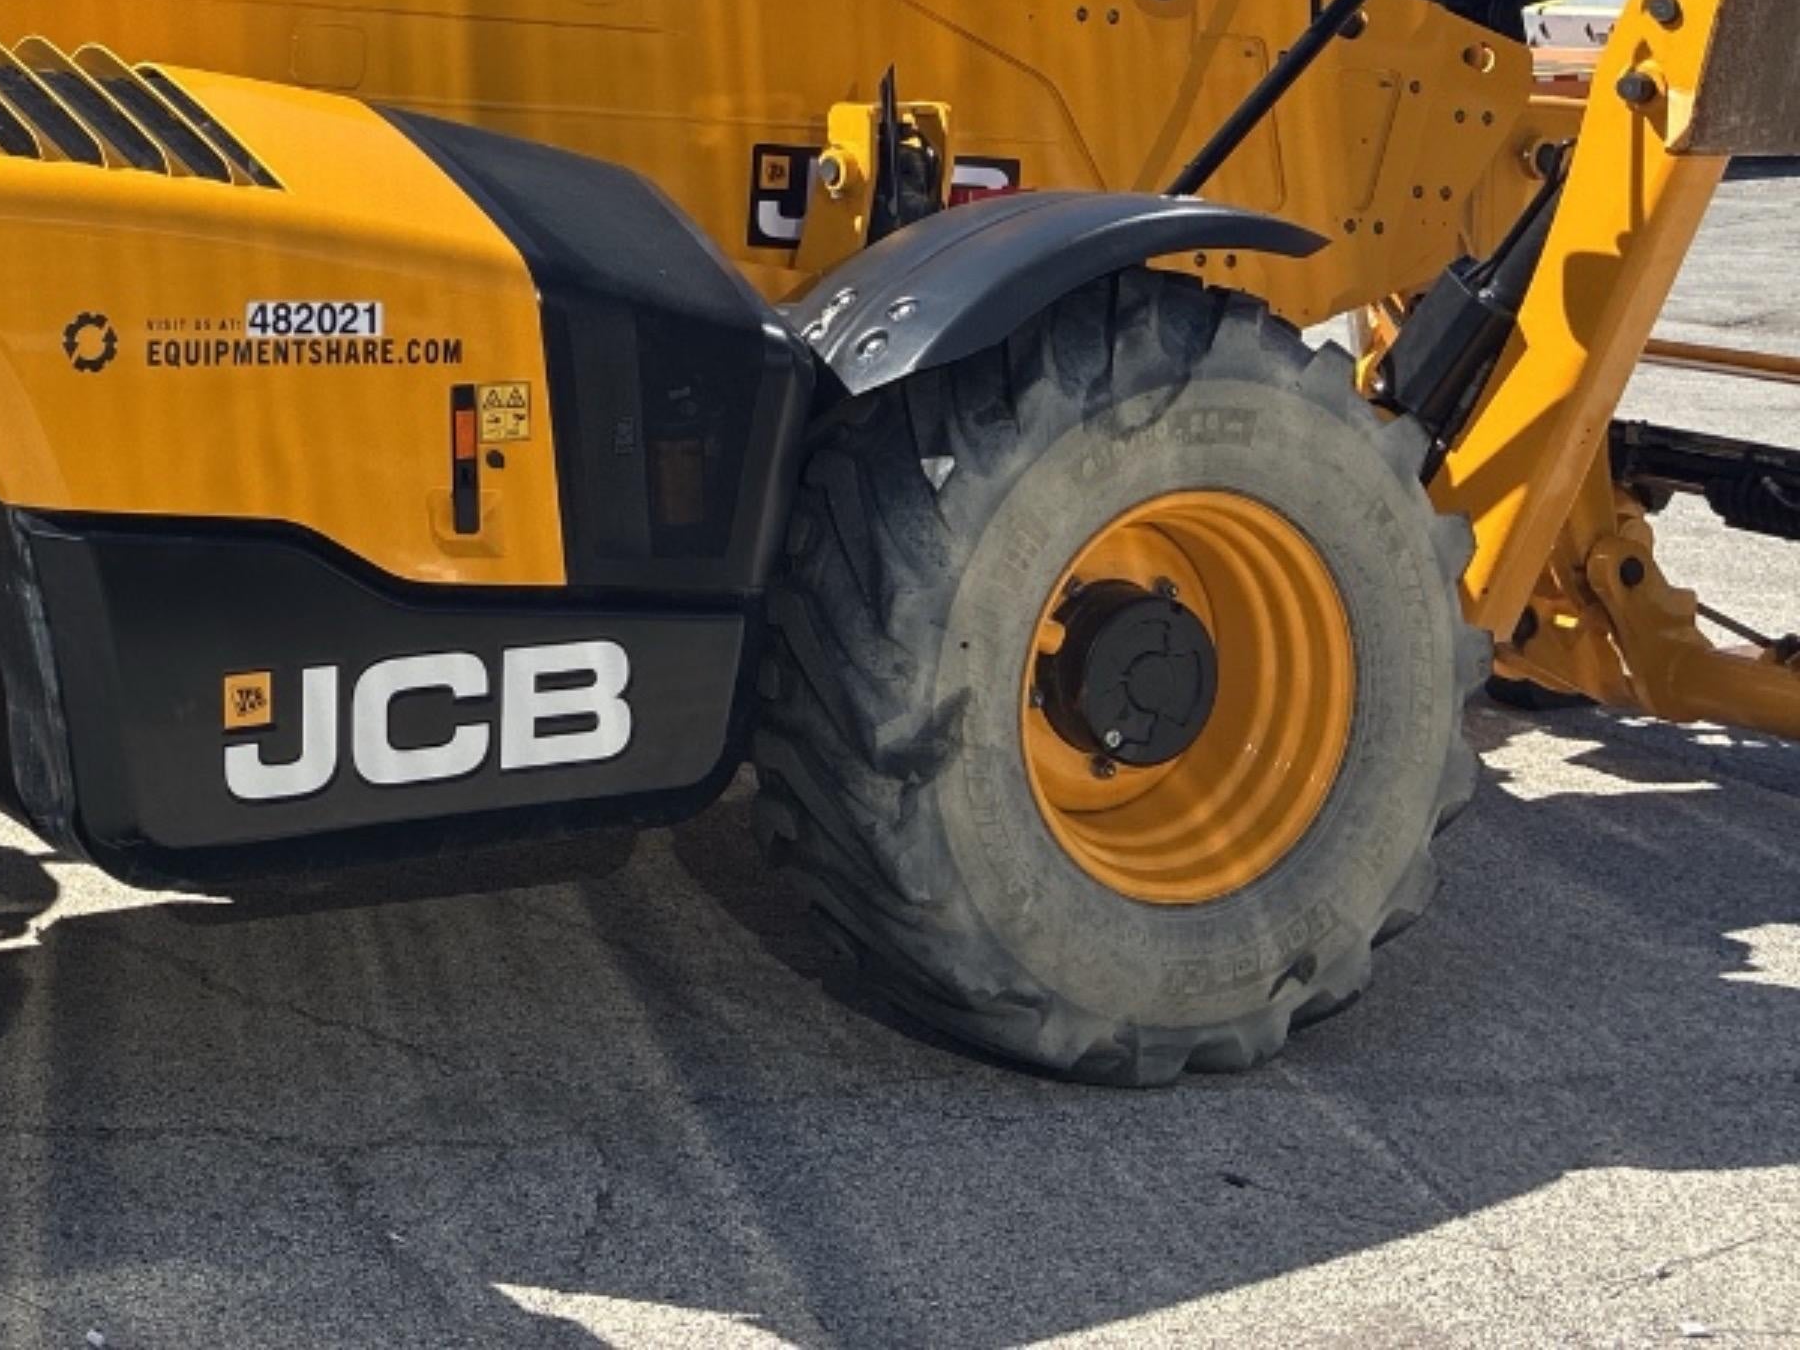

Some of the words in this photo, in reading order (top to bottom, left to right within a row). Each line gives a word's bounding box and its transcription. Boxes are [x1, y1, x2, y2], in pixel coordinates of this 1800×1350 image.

[248, 302, 377, 335] 482021
[147, 337, 463, 367] EQUIPMENTSHARE.COM
[223, 640, 631, 800] JCB
